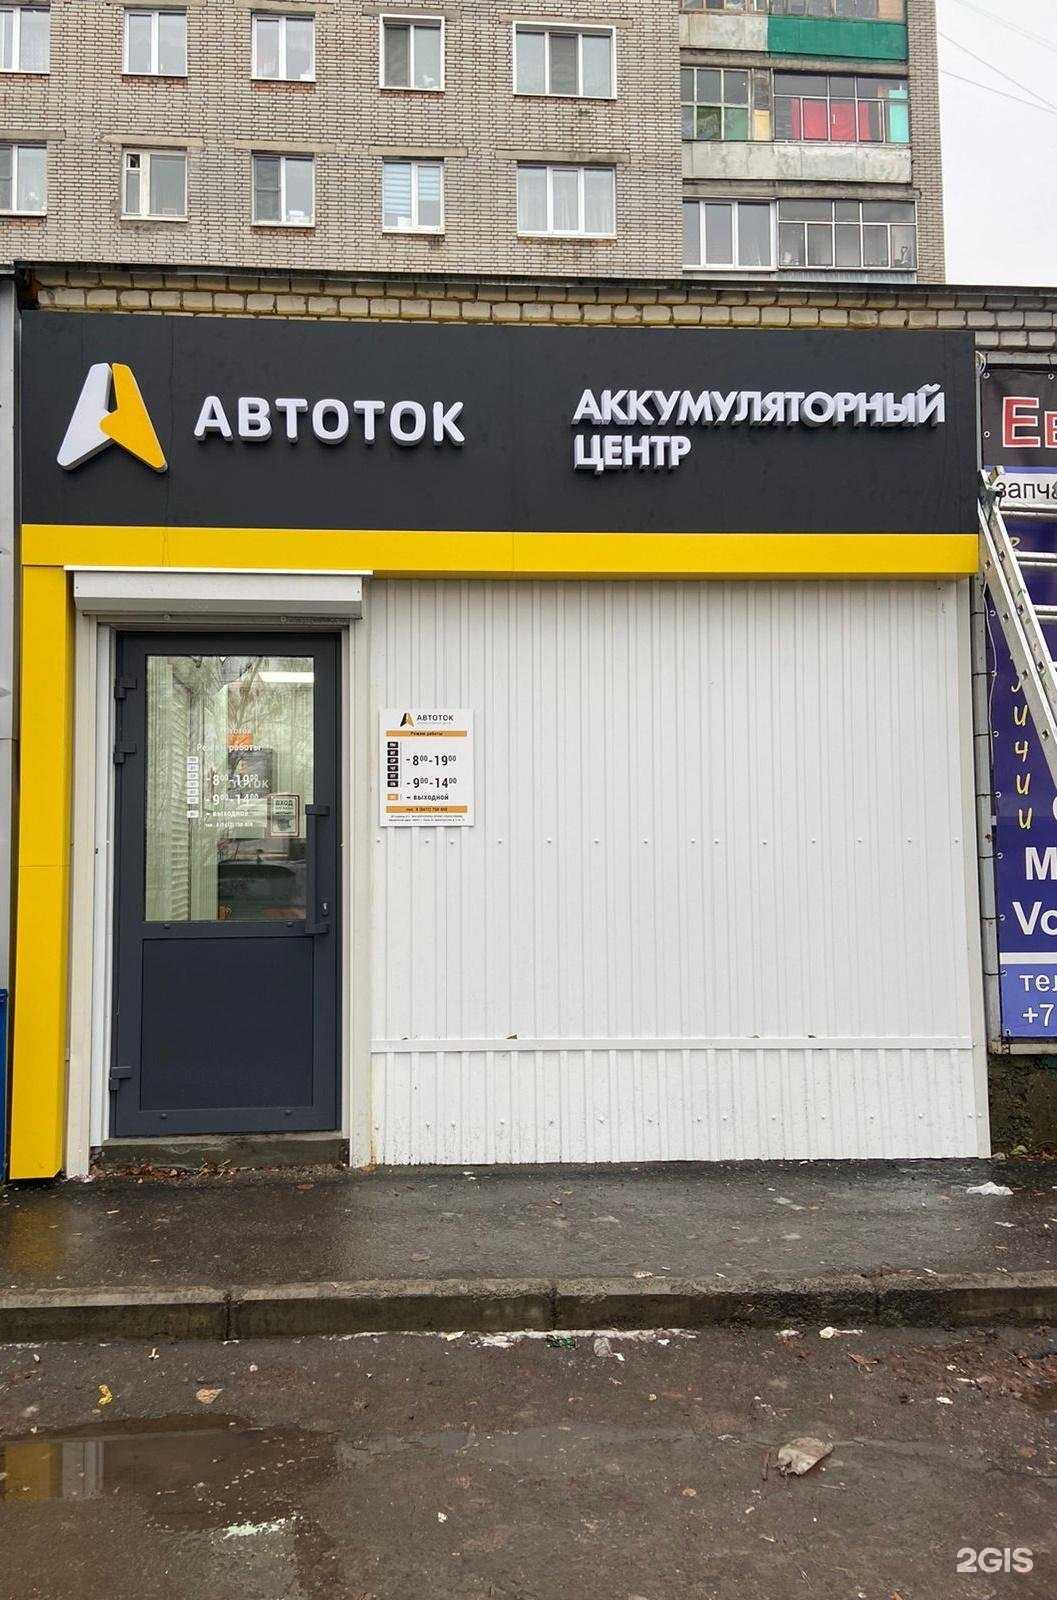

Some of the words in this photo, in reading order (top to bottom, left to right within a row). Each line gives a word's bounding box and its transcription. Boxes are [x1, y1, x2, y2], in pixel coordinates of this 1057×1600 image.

[193, 395, 466, 447] АВТОТОК
[571, 383, 947, 428] АККУМУЛЯТОРНЫЙ
[573, 434, 692, 474] ЦЕНТР
[1022, 1004, 1055, 1027] +7
